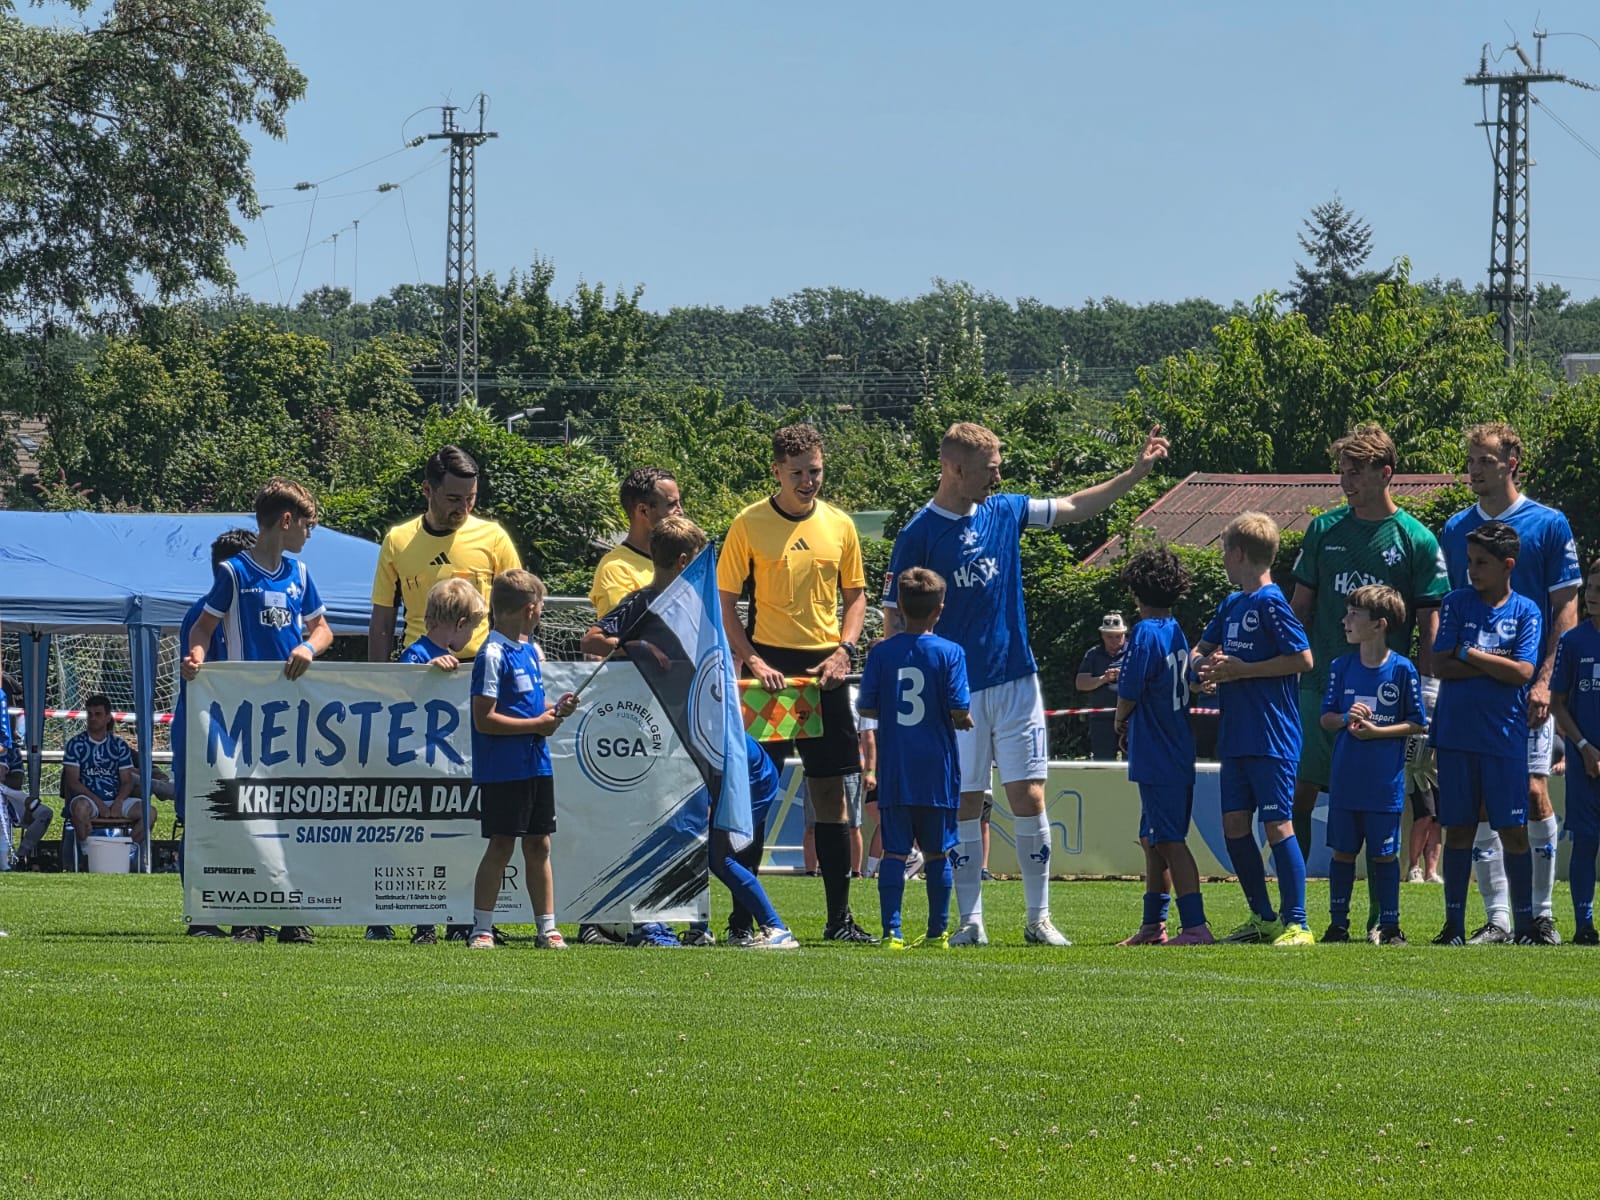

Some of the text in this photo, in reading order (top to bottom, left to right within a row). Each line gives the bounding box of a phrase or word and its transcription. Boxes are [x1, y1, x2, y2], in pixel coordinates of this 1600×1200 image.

[896, 666, 926, 727] 3
[206, 699, 465, 768] MEISTER
[597, 701, 661, 750] SG ARHEILGEN
[597, 738, 648, 758] SGA
[237, 785, 482, 813] KREISOBERLIGA DA/
[295, 825, 425, 844] SAISON 2025/26
[375, 867, 425, 877] KUNST
[375, 880, 447, 891] KOMMERZ
[202, 890, 303, 904] EWADOS
